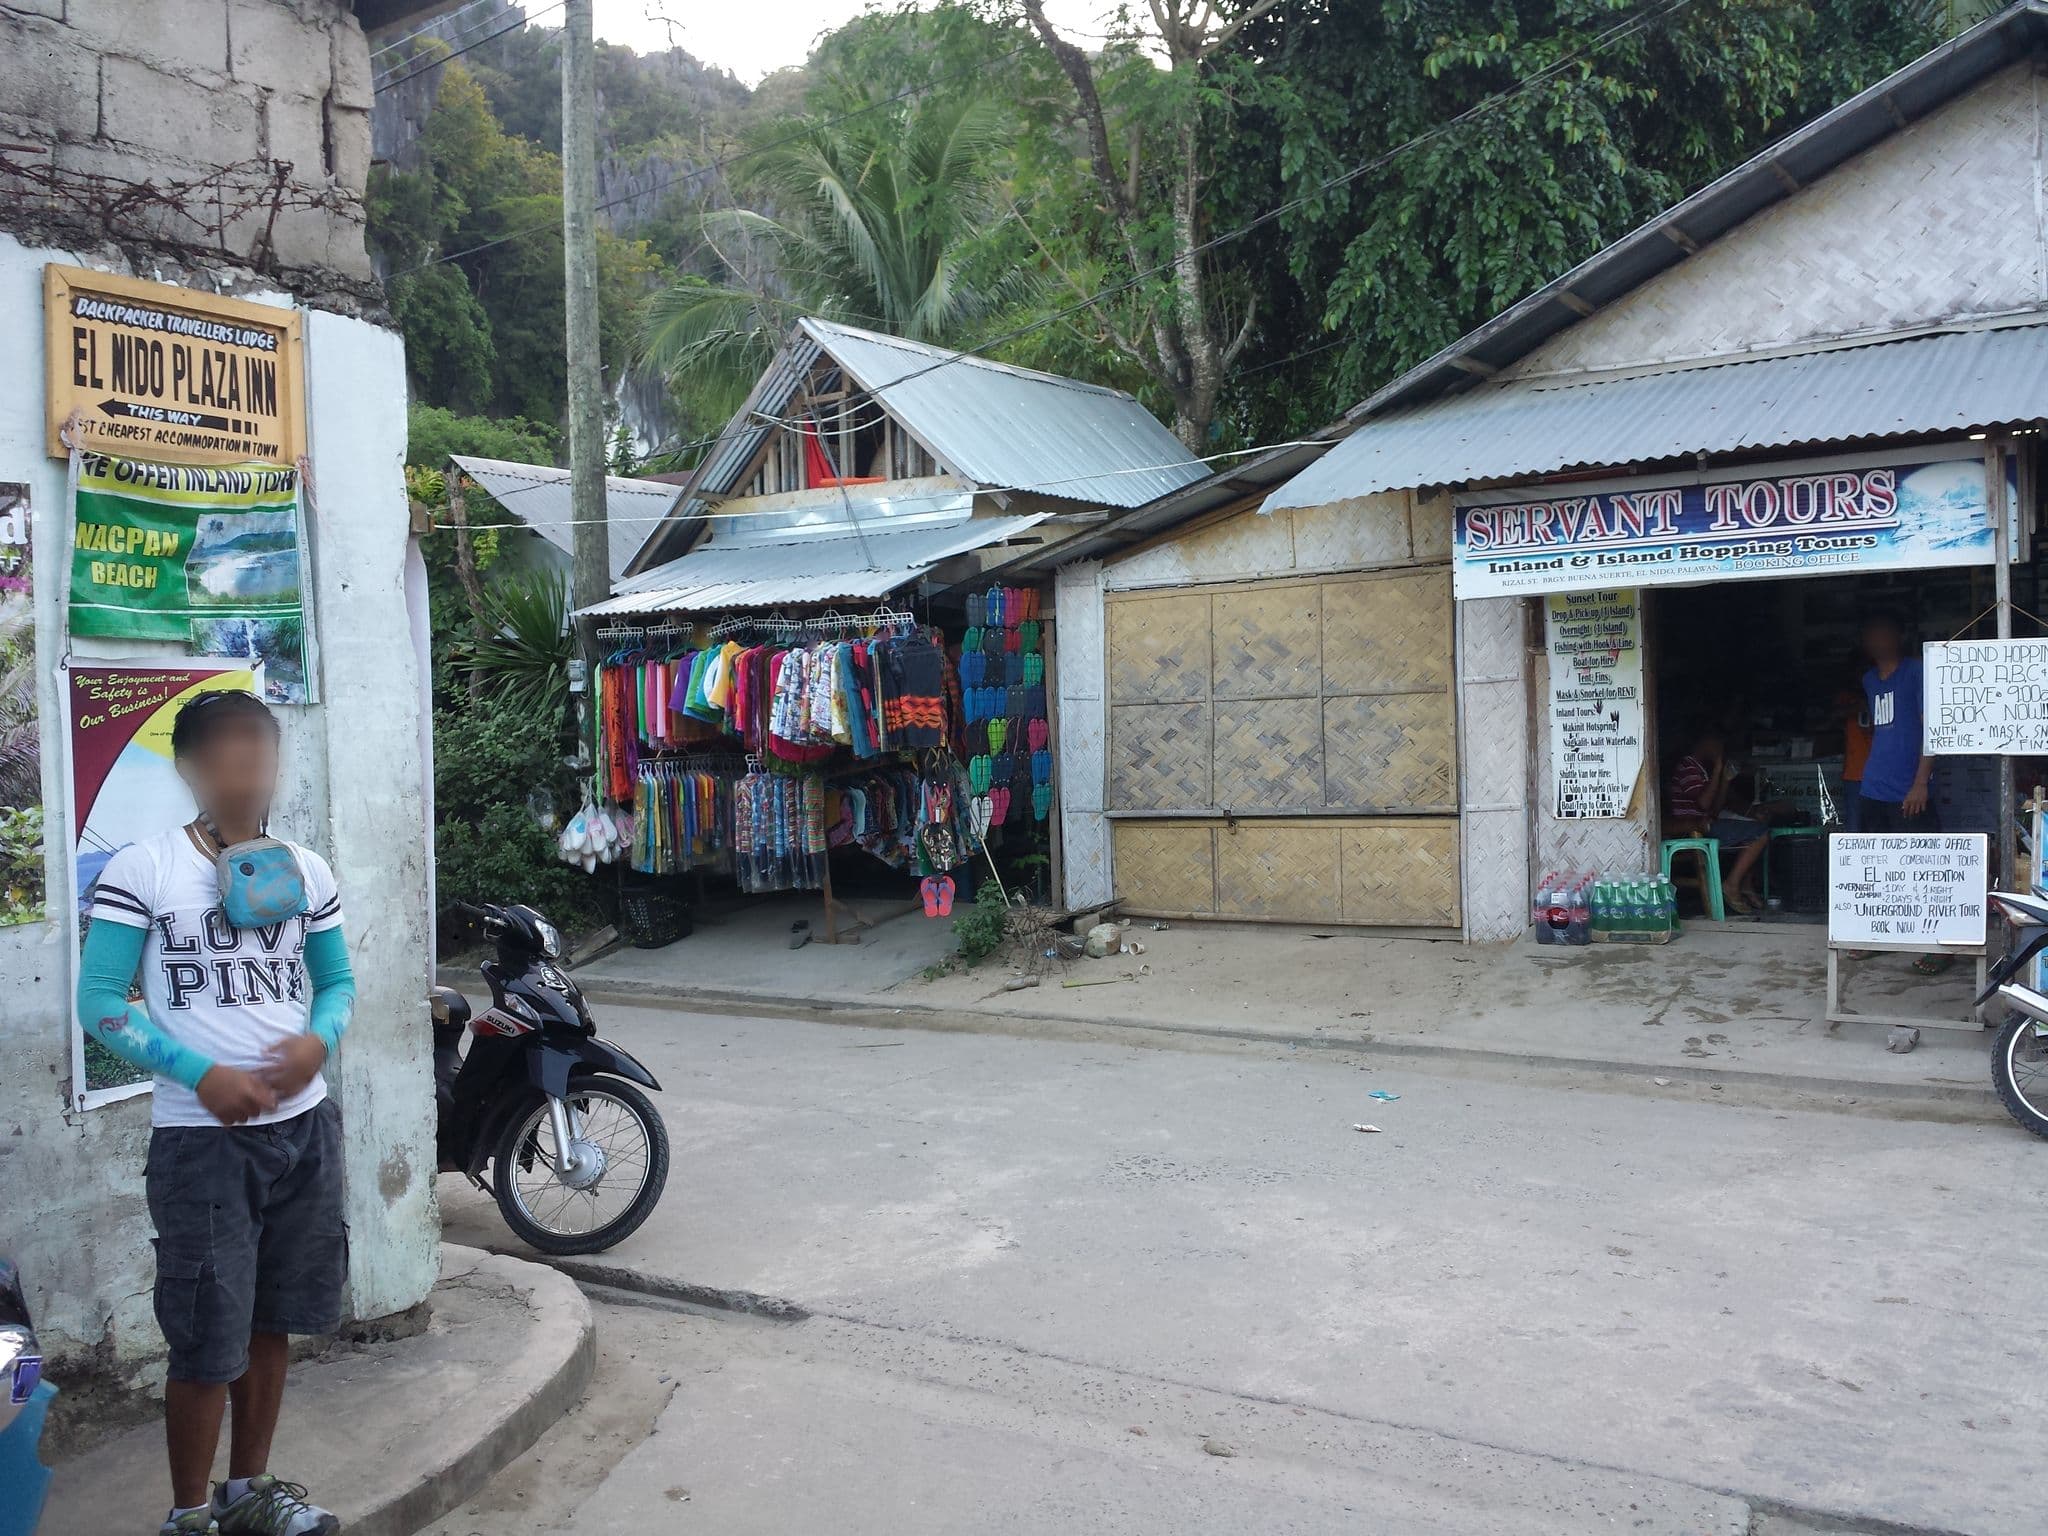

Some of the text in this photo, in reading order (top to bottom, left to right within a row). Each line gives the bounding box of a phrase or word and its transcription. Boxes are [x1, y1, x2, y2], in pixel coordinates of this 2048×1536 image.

[76, 297, 275, 350] BACKPACKER TRAVELLERS LODGE
[73, 327, 278, 418] EL NIDO PLAZA INN
[127, 403, 202, 427] THIS WAY
[99, 421, 151, 442] CHEAPEST
[154, 430, 241, 455] ACCOMMODATION
[242, 439, 251, 451] IN
[252, 441, 279, 459] TOWN
[115, 458, 179, 491] OFFER
[185, 466, 251, 495] INLAND
[1466, 469, 1897, 552] SERVANT TOURS
[76, 522, 179, 559] NACPAN
[1489, 535, 1876, 574] Inland & Island Hopping Tours
[92, 563, 158, 588] BEACH
[1502, 579, 1525, 587] RIZAL
[1568, 573, 1597, 582] BUENA
[1599, 570, 1634, 580] SUERTE,
[1636, 569, 1648, 577] EL
[1677, 564, 1720, 575] PALAWAN
[1734, 555, 1804, 570] BOOKING
[1807, 551, 1861, 564] OFFICE
[1567, 591, 1618, 605] Sunset Tour
[1552, 610, 1567, 621] Drop
[1575, 608, 1588, 618] Pick
[1610, 604, 1633, 617] Island)
[1560, 623, 1590, 637] Overnight
[1603, 621, 1626, 634] Island)
[1555, 641, 1577, 653] Fishing
[1579, 640, 1591, 650] with
[1594, 639, 1608, 649] Hook
[1618, 638, 1633, 648] Line
[1573, 656, 1614, 667] Boat for Hire
[1946, 646, 1998, 663] ISLAND
[75, 673, 190, 687] Your Enjoyment and
[1936, 665, 1984, 684] TOUR
[89, 687, 148, 702] Safety is
[1556, 688, 1571, 699] Mask
[1580, 687, 1605, 698] Snorkel
[1606, 687, 1616, 697] for
[1940, 686, 1996, 706] LEAVE
[79, 686, 169, 729] Our Business!
[1556, 707, 1575, 717] Inland
[1940, 706, 1987, 725] BOOK
[1563, 722, 1616, 733] Makinit Hotspring
[1929, 726, 1957, 736] WITH
[1606, 735, 1637, 746] Waterfalls
[1930, 737, 1954, 749] FREE
[1957, 733, 1974, 747] USE
[1563, 752, 1604, 763] Cliff Climbing
[1560, 769, 1577, 779] Shuttle
[1578, 769, 1588, 778] Van
[1569, 784, 1581, 793] Nido
[1582, 784, 1588, 793] to
[1589, 783, 1605, 793] Puerto
[1562, 800, 1574, 810] Boat
[1576, 800, 1587, 810] Trip
[1589, 800, 1594, 810] to
[1596, 800, 1612, 810] Coron
[1837, 838, 1973, 850] SERVANT TOURS BOOKING OFFICE
[1840, 854, 1979, 866] WE OFFER COMBINATION TOUR
[1864, 867, 1965, 882] EL NIDO EXPEDITION
[1891, 884, 1906, 893] DAY
[1930, 886, 1953, 894] NIGHT
[1891, 894, 1912, 903] DAYS
[1930, 895, 1953, 903] NIGHT
[1834, 902, 1980, 917] ALSO UNDERGROUND RIVER TOUR
[1871, 921, 1890, 932] BOOK
[1897, 921, 1915, 932] NOW
[487, 1015, 515, 1034] SUZUKI
